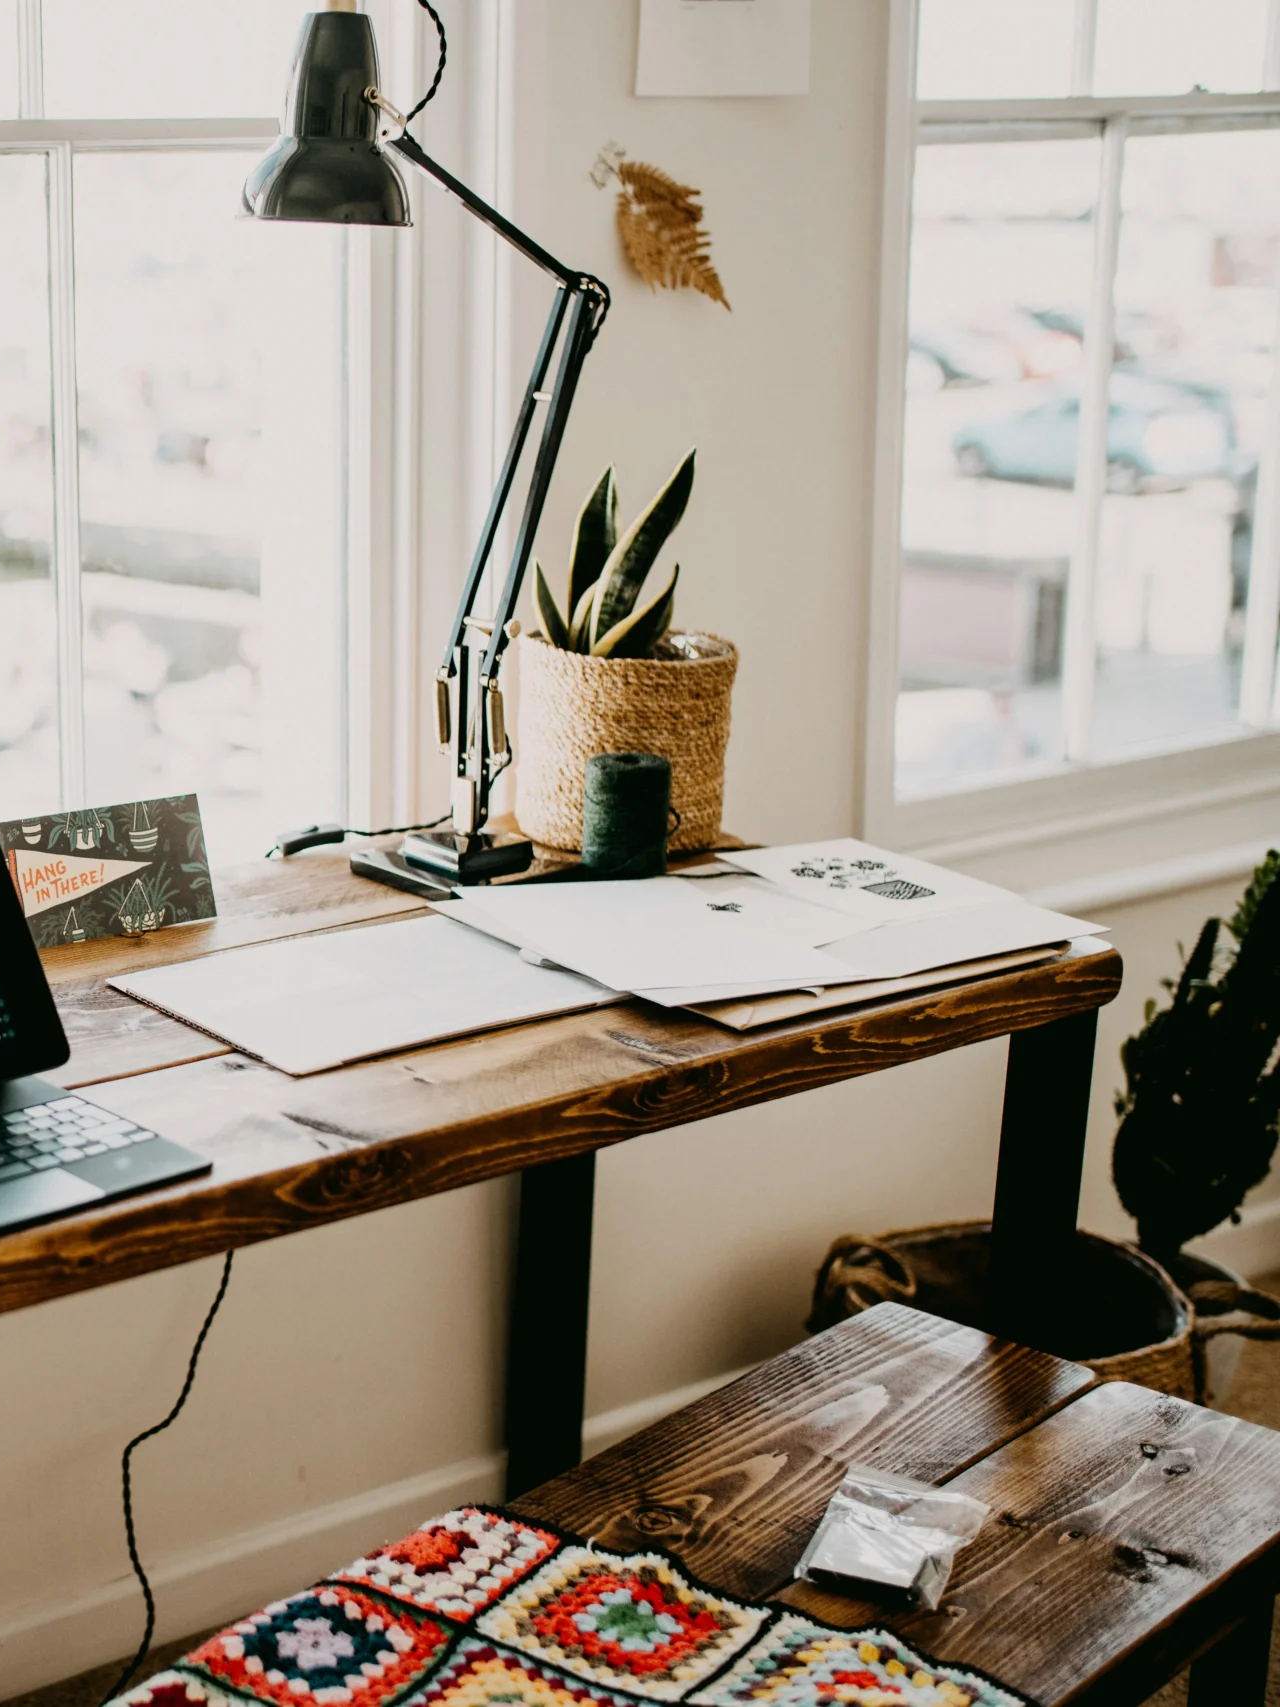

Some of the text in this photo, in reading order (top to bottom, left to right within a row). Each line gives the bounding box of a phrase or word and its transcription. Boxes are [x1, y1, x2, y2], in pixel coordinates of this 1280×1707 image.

[21, 860, 67, 894] HANG
[35, 862, 105, 904] IN THERE!
